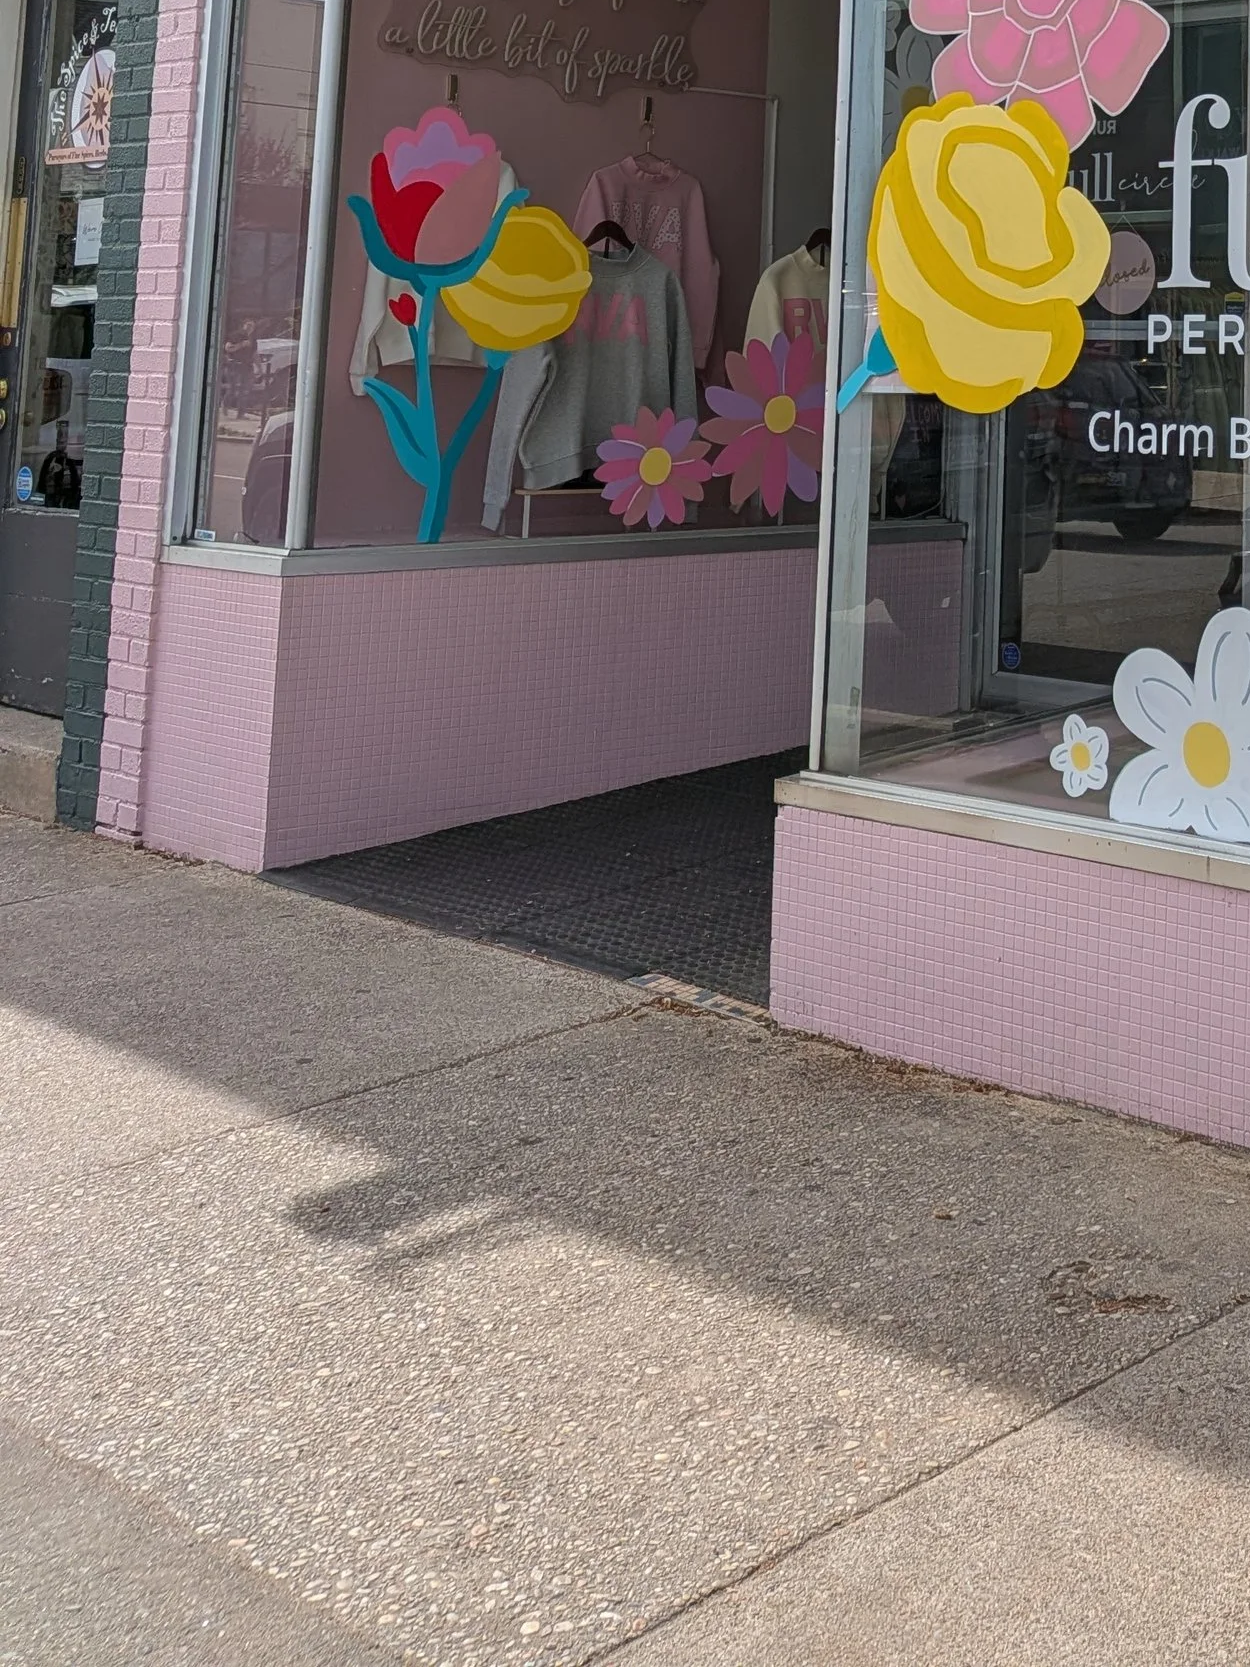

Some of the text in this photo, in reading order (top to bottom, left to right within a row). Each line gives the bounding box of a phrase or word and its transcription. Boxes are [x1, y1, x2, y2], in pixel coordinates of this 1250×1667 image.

[101, 6, 118, 34] Te
[385, 23, 411, 46] a
[503, 13, 566, 70] bit
[556, 26, 590, 94] of
[588, 33, 695, 97] sparkle
[1067, 151, 1116, 202] ull
[1097, 258, 1151, 288] losed
[1088, 411, 1214, 458] Charm
